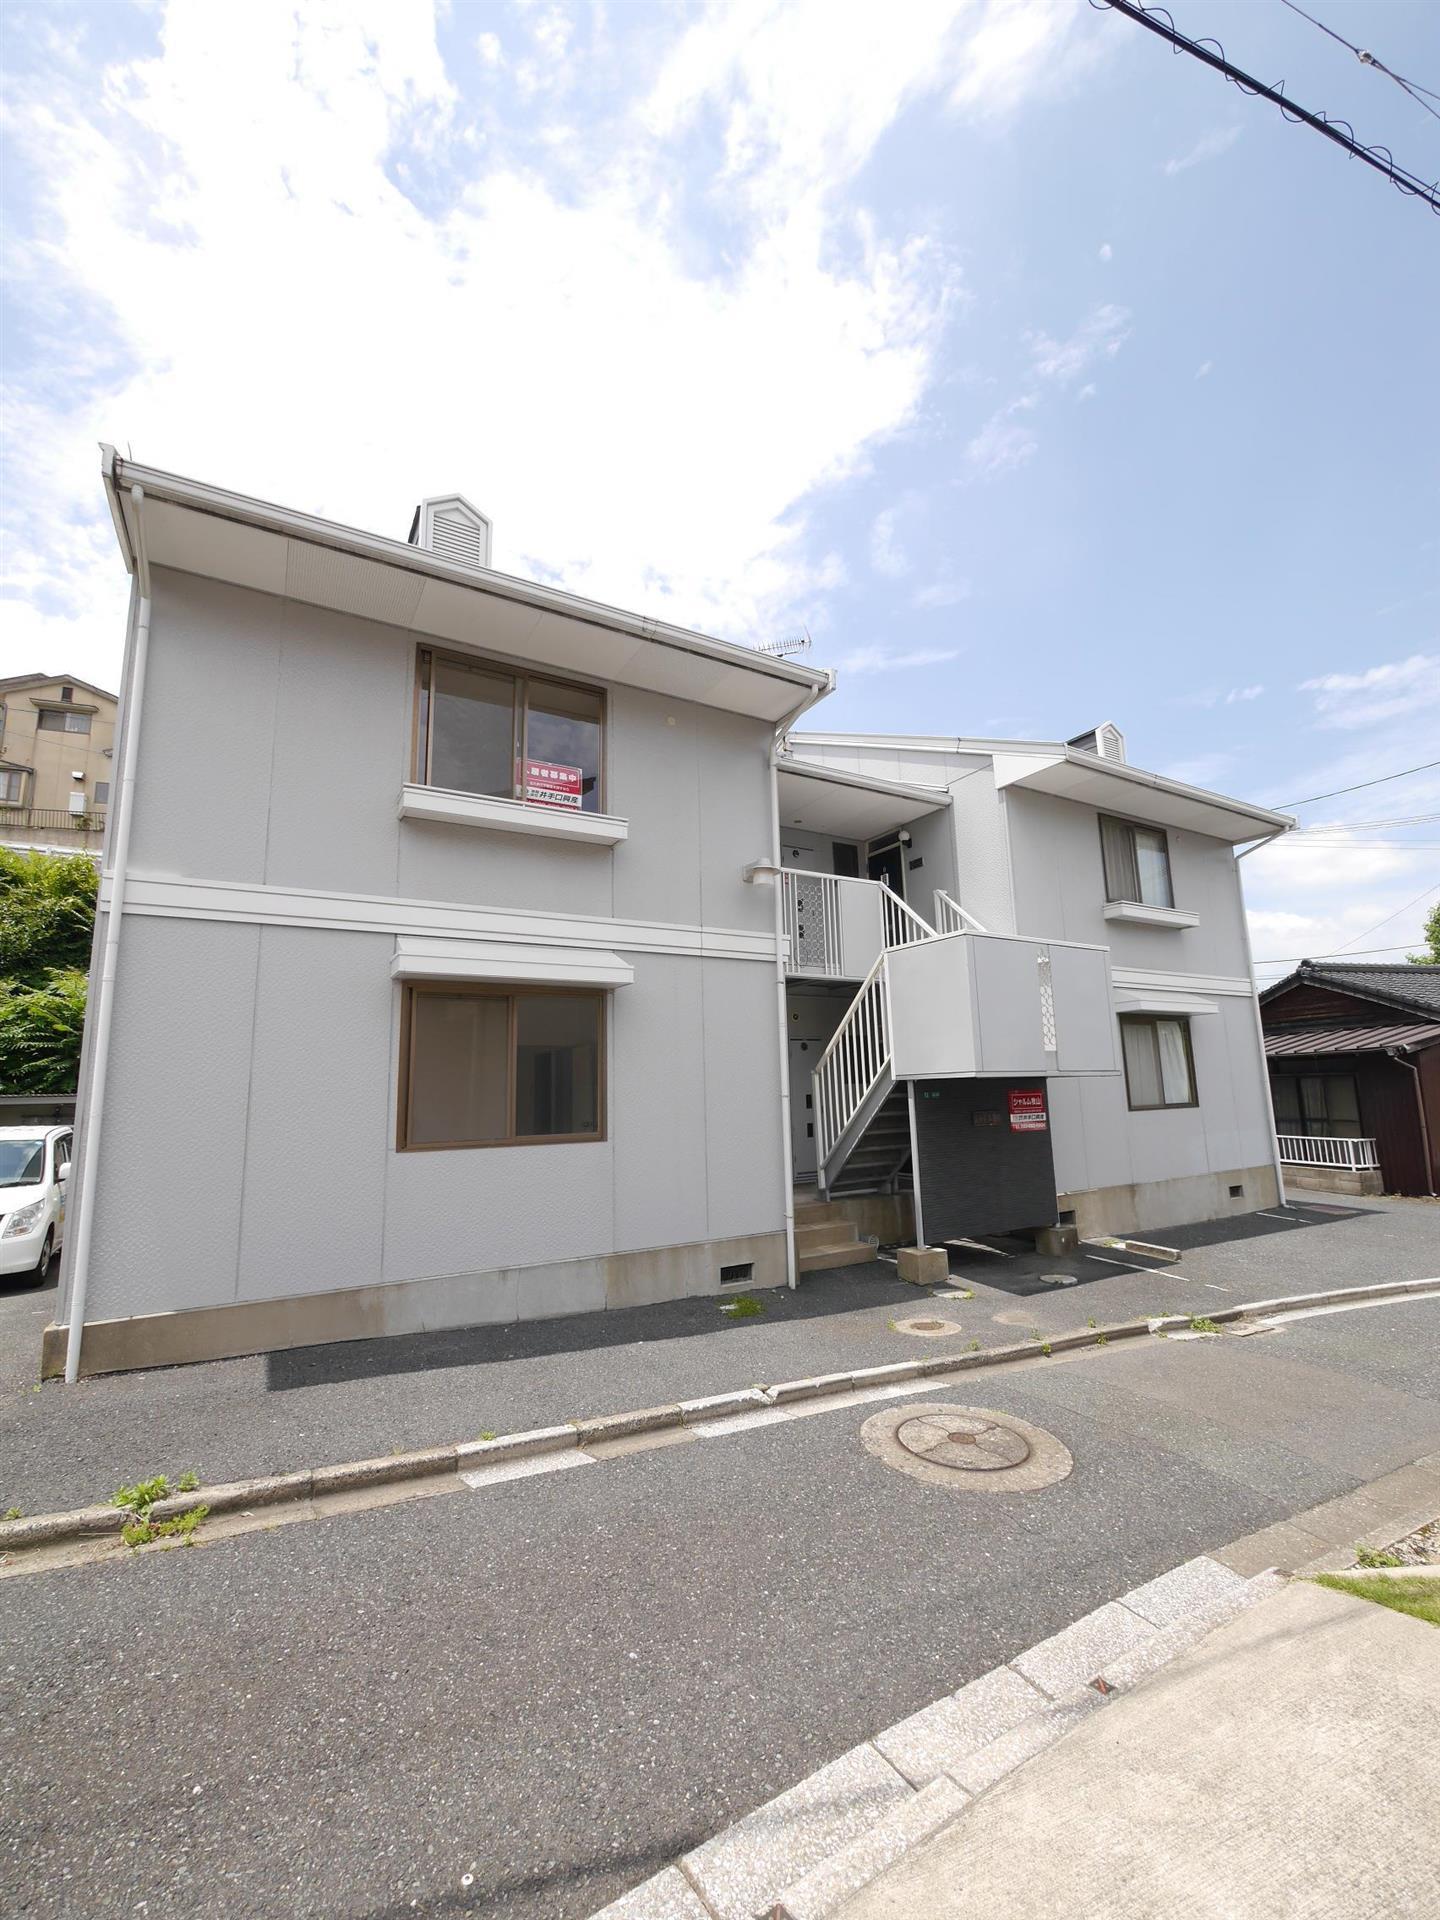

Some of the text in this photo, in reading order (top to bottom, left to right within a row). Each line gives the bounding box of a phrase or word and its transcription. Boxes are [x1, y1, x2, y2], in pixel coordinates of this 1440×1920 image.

[526, 767, 577, 782] 居者募集中
